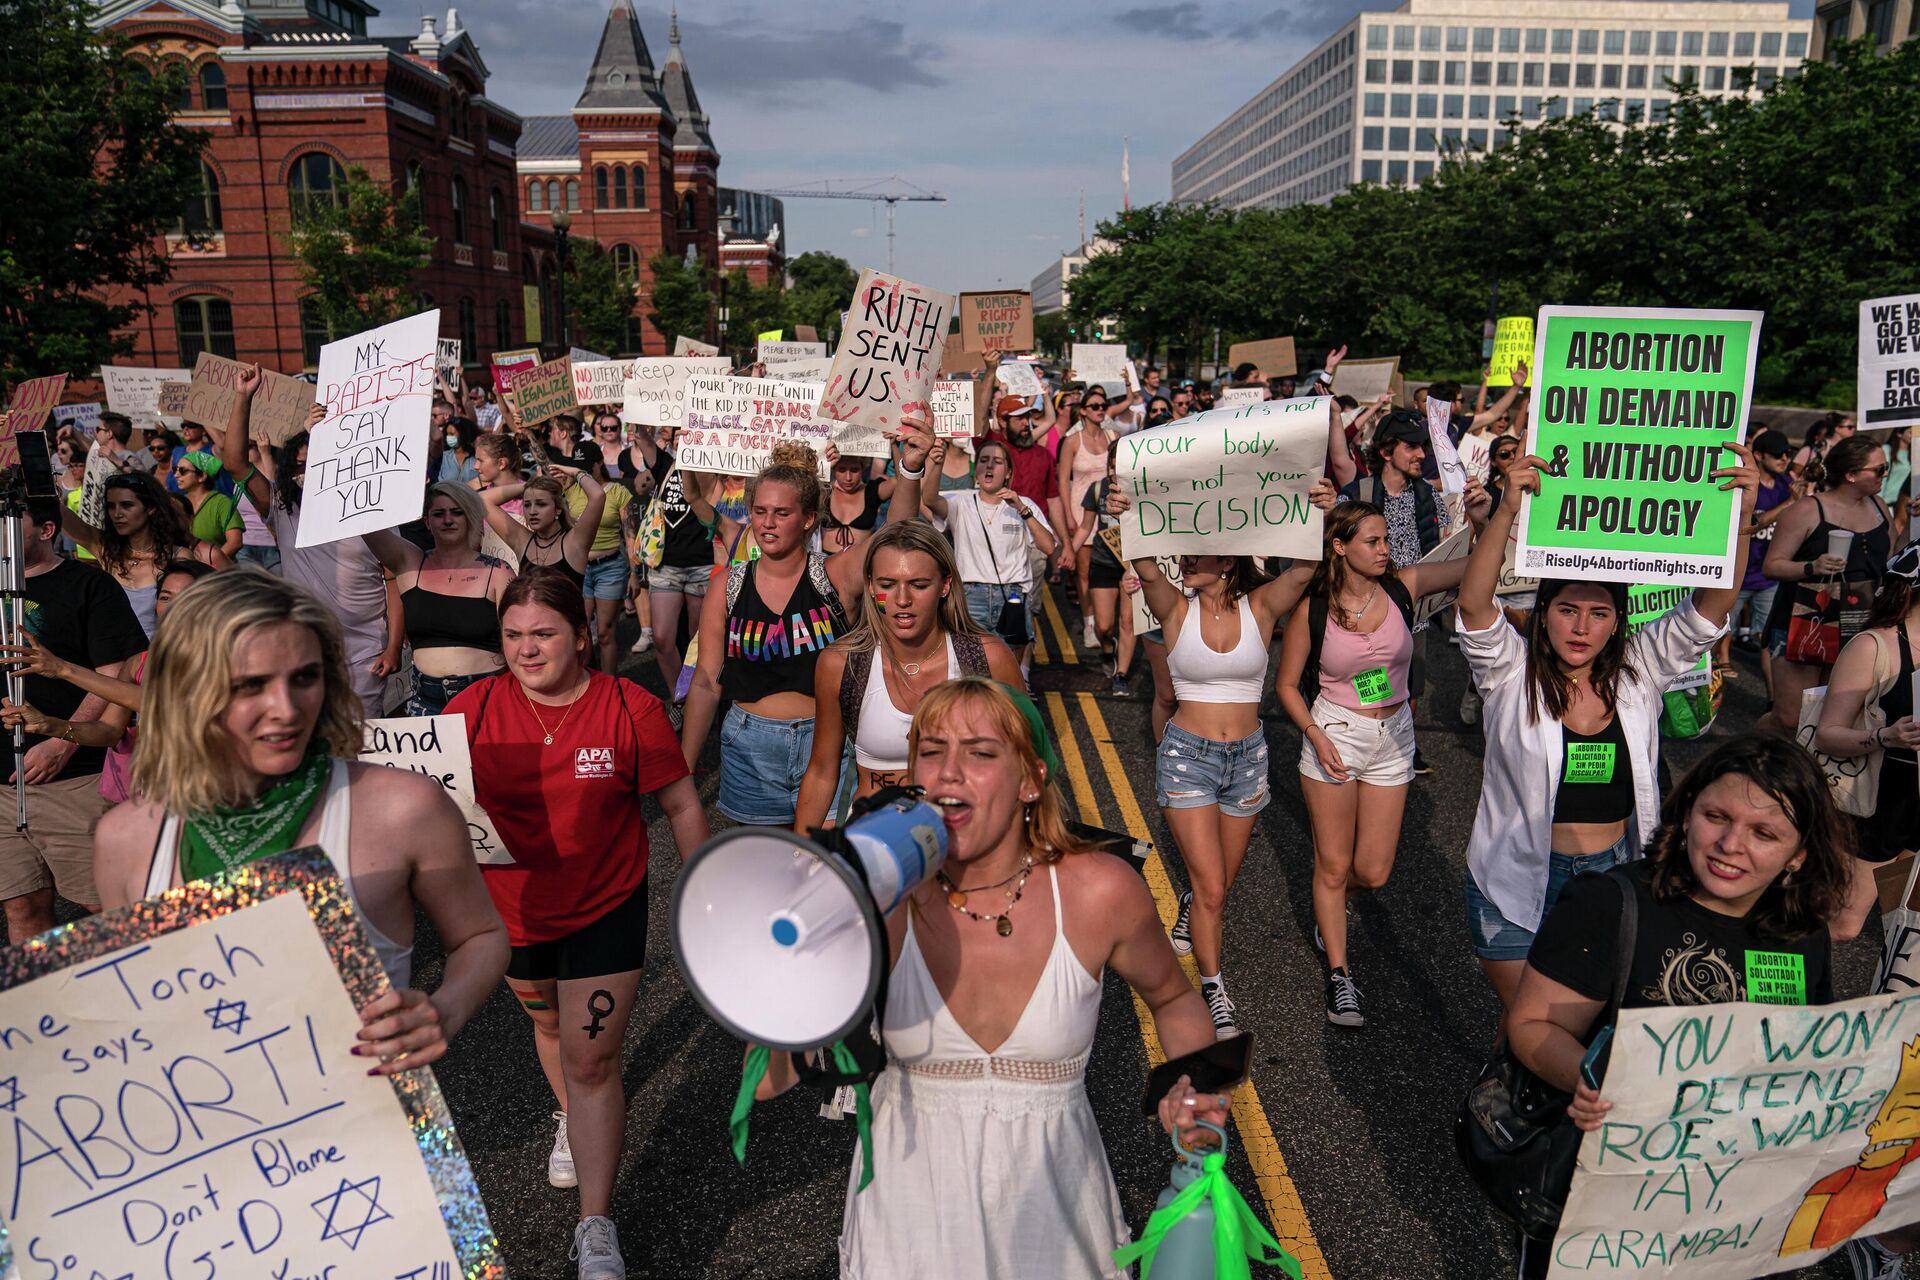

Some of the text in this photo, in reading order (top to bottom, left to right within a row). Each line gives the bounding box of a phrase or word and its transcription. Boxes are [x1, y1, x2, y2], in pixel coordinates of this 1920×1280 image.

[975, 295, 1022, 309] WOMENS
[1871, 304, 1902, 323] WE
[865, 286, 943, 349] RUTH
[980, 308, 1021, 322] RIGHTS
[978, 321, 1015, 335] HAPPY
[1877, 321, 1903, 339] GO
[848, 329, 930, 371] SENT
[982, 335, 1015, 350] WIFE
[1565, 331, 1726, 375] ABORTION
[1877, 337, 1907, 355] WE
[355, 338, 386, 373] MY
[325, 352, 435, 416] RAPISTS
[511, 358, 568, 390] FEDERALLY
[575, 365, 624, 383] NO UTERU
[633, 364, 675, 386] keep
[849, 368, 892, 404] US.
[162, 383, 191, 394] SCOTU
[517, 374, 569, 408] LEGALIZE
[577, 386, 593, 400] NO
[639, 387, 671, 404] ban
[728, 377, 784, 395] "PRO-LIFE"
[784, 386, 817, 401] UNTIL
[940, 392, 970, 402] WITH A
[1223, 391, 1260, 401] WOMEN
[166, 403, 186, 413] OFF
[519, 391, 576, 422] ABORTION!
[691, 399, 812, 421] THE KID IS TRANS,
[1544, 385, 1738, 431] ON DEMAND
[335, 405, 391, 449] SAY
[682, 431, 704, 446] OR
[706, 432, 721, 446] A
[688, 412, 749, 431] BLACK,
[751, 416, 787, 437] GAY,
[790, 420, 831, 440] POOR,
[681, 448, 775, 472] GUN VIOLENC
[1129, 427, 1280, 470] your body.
[310, 434, 411, 490] THANK
[1549, 441, 1724, 485] & WITHOUT
[1133, 464, 1311, 498] it's not your
[337, 475, 384, 518] YOU
[1136, 493, 1311, 537] DECISION
[1556, 494, 1703, 539] APOLOGY
[1497, 568, 1539, 588] AGAI
[1545, 553, 1724, 579] RiseUp4AbortionRights.org
[727, 606, 837, 662] HUMAN
[1354, 668, 1382, 682] OVERTURN
[1359, 686, 1377, 699] HELL
[1376, 681, 1389, 693] NO!
[577, 749, 612, 762] APA
[1603, 744, 1608, 752] A
[1608, 753, 1612, 761] Y
[1575, 761, 1606, 769] SIN PEDIR
[75, 933, 264, 1010] Torah
[1790, 956, 1796, 967] A
[1749, 967, 1801, 982] SOLICITADO Y
[1757, 981, 1797, 994] SIN PEDIR
[62, 1027, 154, 1074] says
[1642, 1013, 1734, 1076] YOU
[1668, 1066, 1866, 1121] DEFEND
[9, 1014, 326, 1222] ABORT!
[1599, 1088, 1887, 1167] ROE v. WADE?
[122, 1173, 220, 1246] Don't
[252, 1137, 346, 1188] Blame
[1555, 1216, 1764, 1271] CARAMBA!
